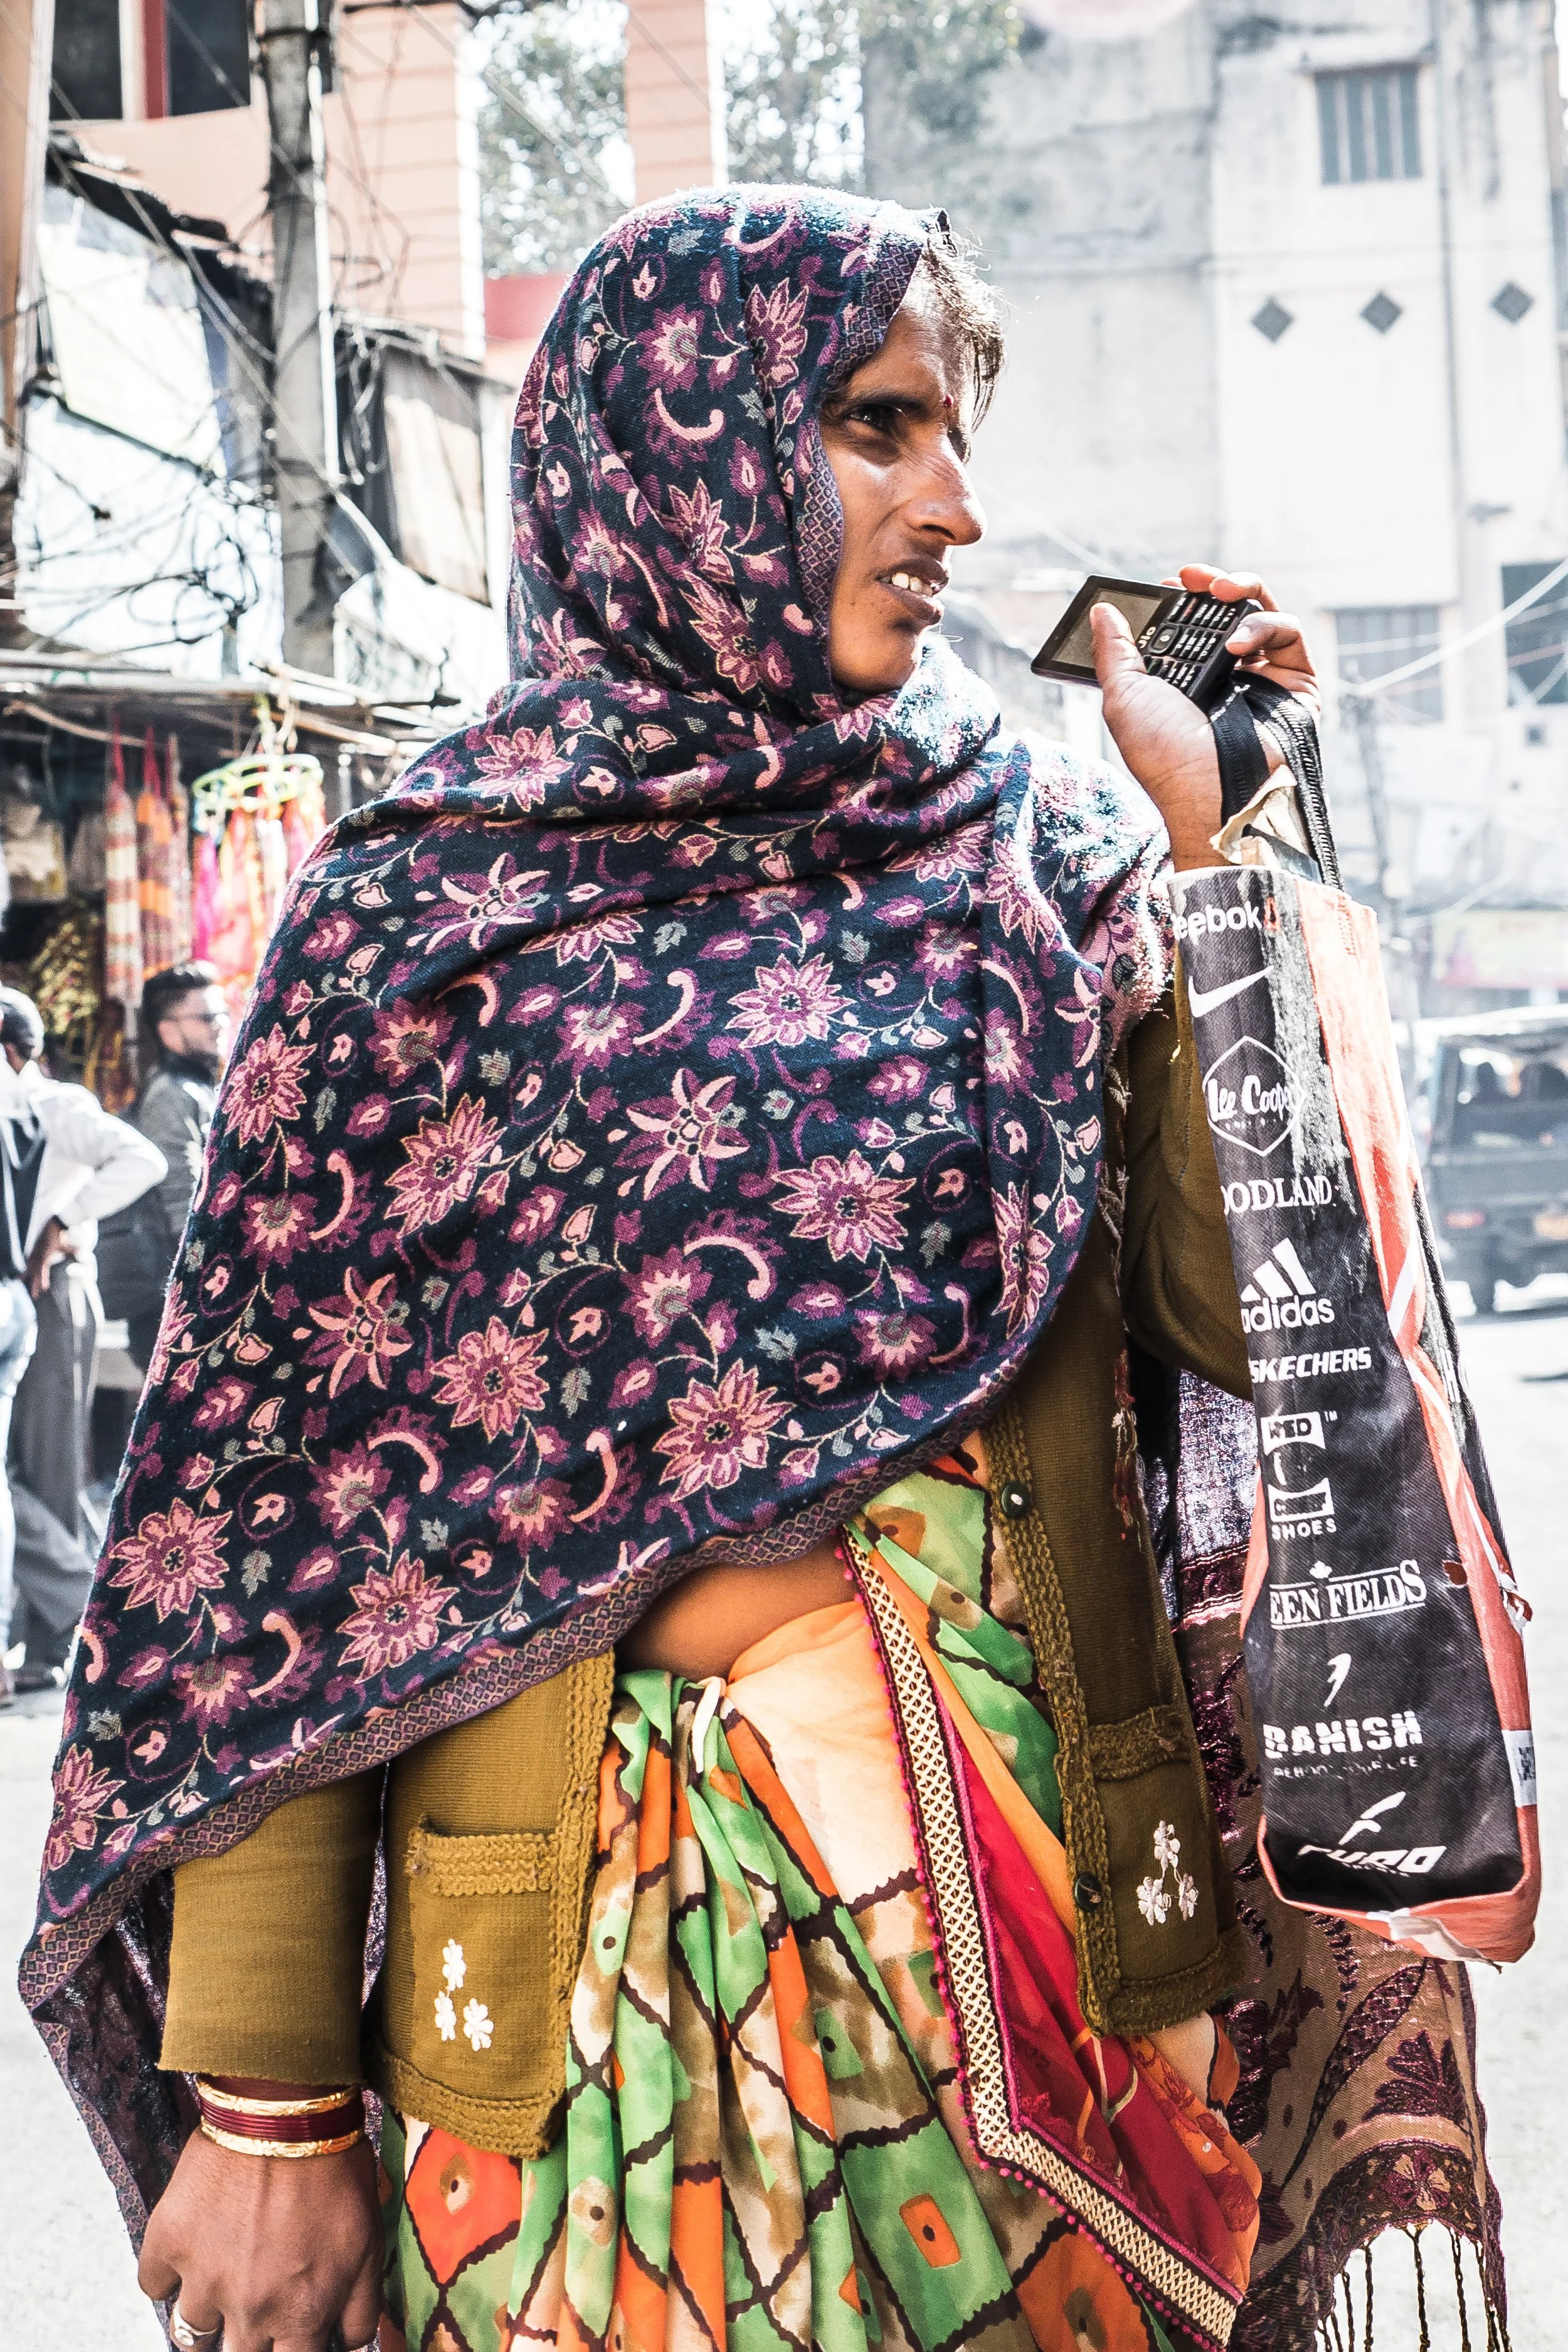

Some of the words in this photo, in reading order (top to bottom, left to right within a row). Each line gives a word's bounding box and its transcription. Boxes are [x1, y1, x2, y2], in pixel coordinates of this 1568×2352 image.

[1170, 901, 1263, 944] eebok
[1207, 1078, 1237, 1122] Lee
[1249, 1347, 1372, 1383] SKECHERS
[1271, 1518, 1337, 1540] SHOES
[1326, 1559, 1427, 1616] FIELDS
